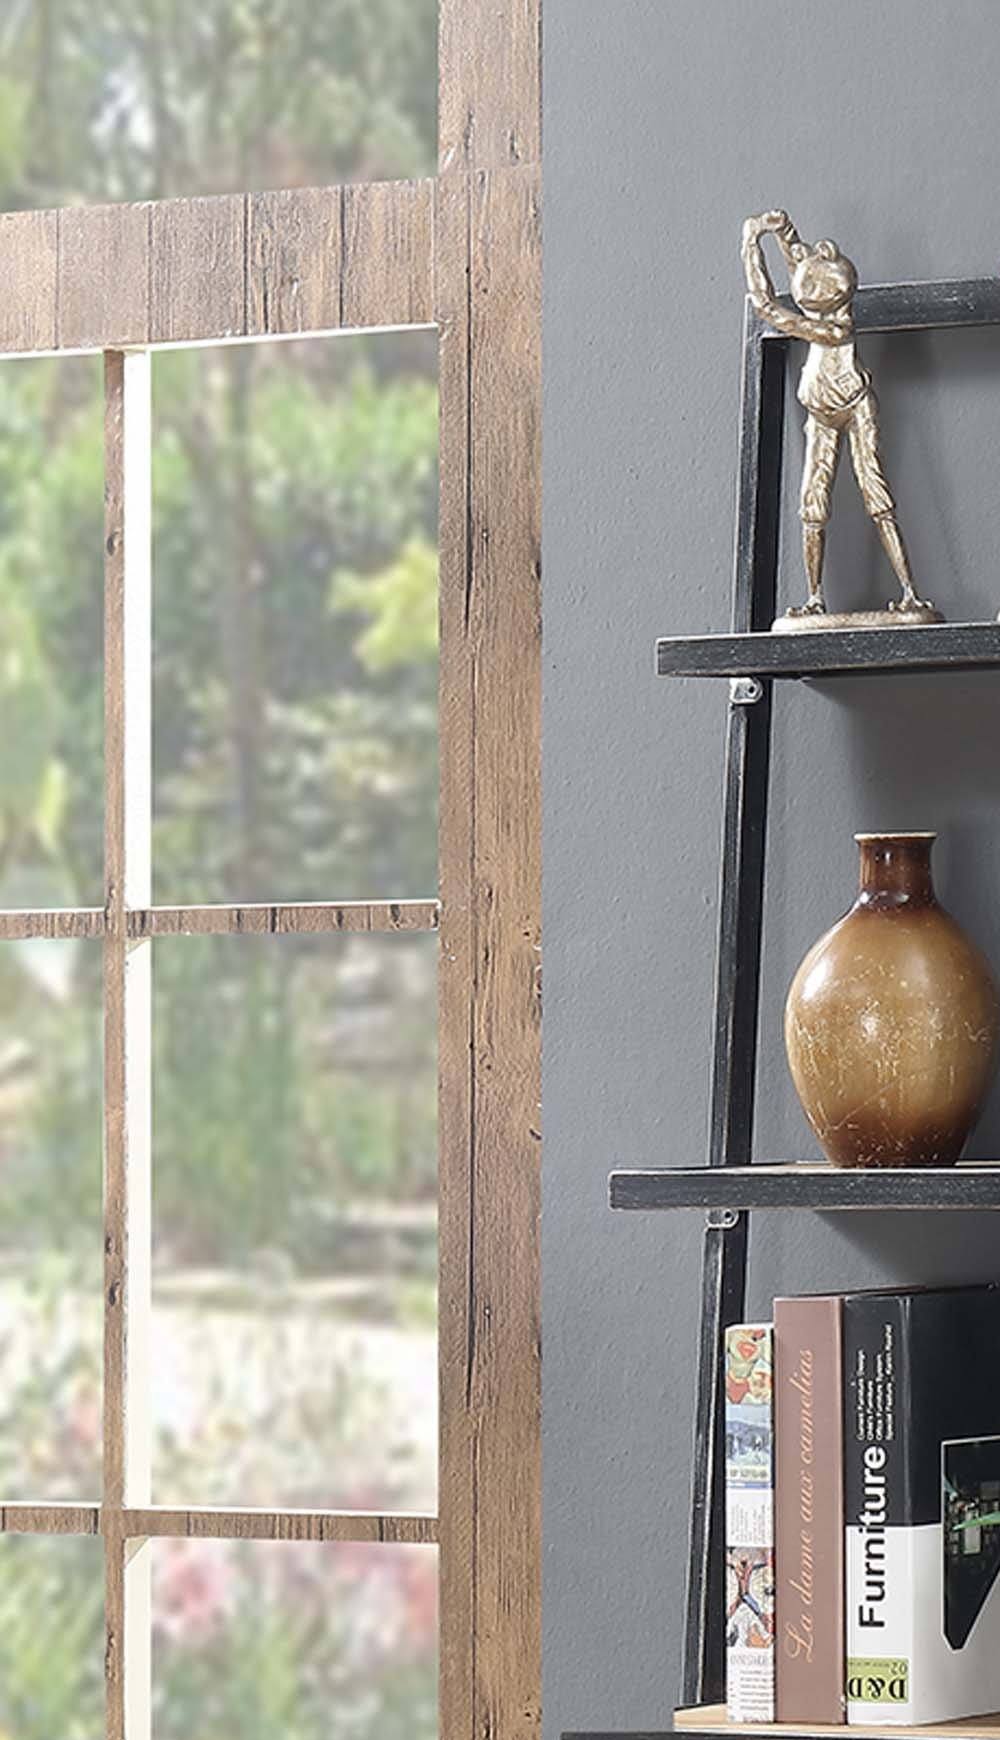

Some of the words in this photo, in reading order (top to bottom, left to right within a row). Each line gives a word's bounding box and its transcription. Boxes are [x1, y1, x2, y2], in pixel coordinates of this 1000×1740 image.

[800, 1469, 815, 1523] aux
[858, 1445, 887, 1628] Furniture
[788, 1529, 814, 1606] dame
[784, 1613, 814, 1664] La
[849, 1677, 905, 1699] D&D
